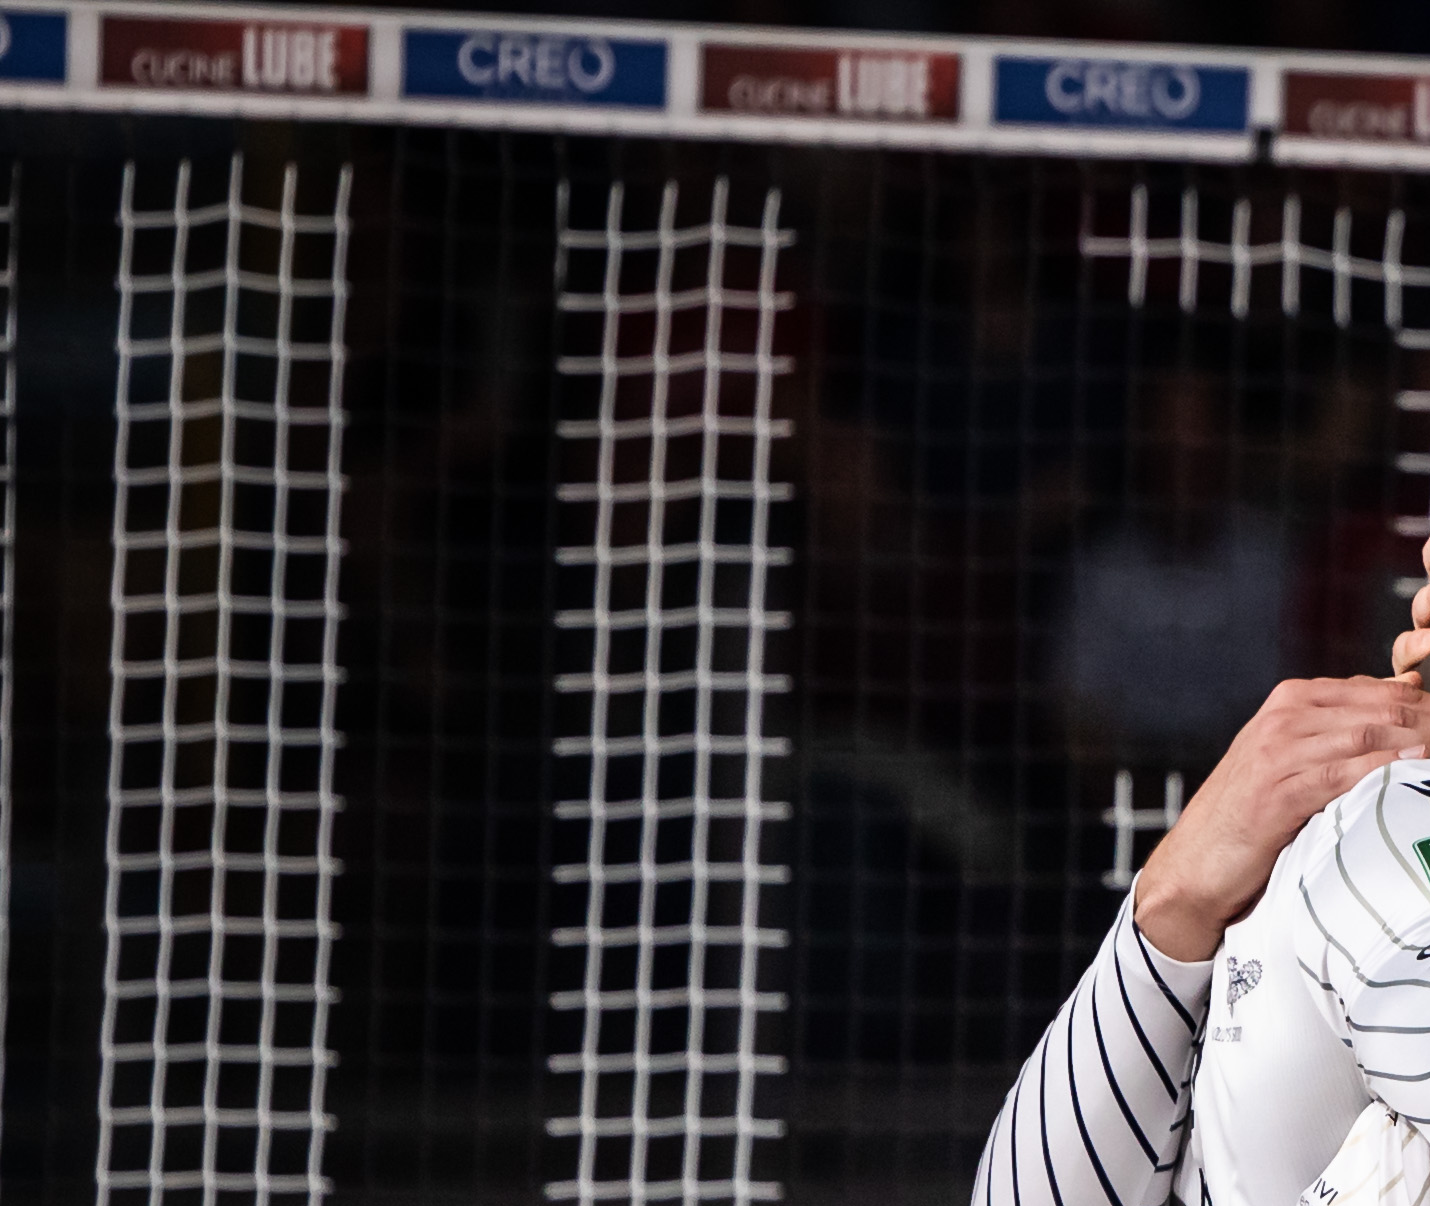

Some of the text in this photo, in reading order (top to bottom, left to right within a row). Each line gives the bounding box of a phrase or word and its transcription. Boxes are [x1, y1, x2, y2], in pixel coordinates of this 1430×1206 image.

[243, 25, 336, 90] LUBE
[458, 36, 615, 92] CREO
[1044, 62, 1200, 120] CREO
